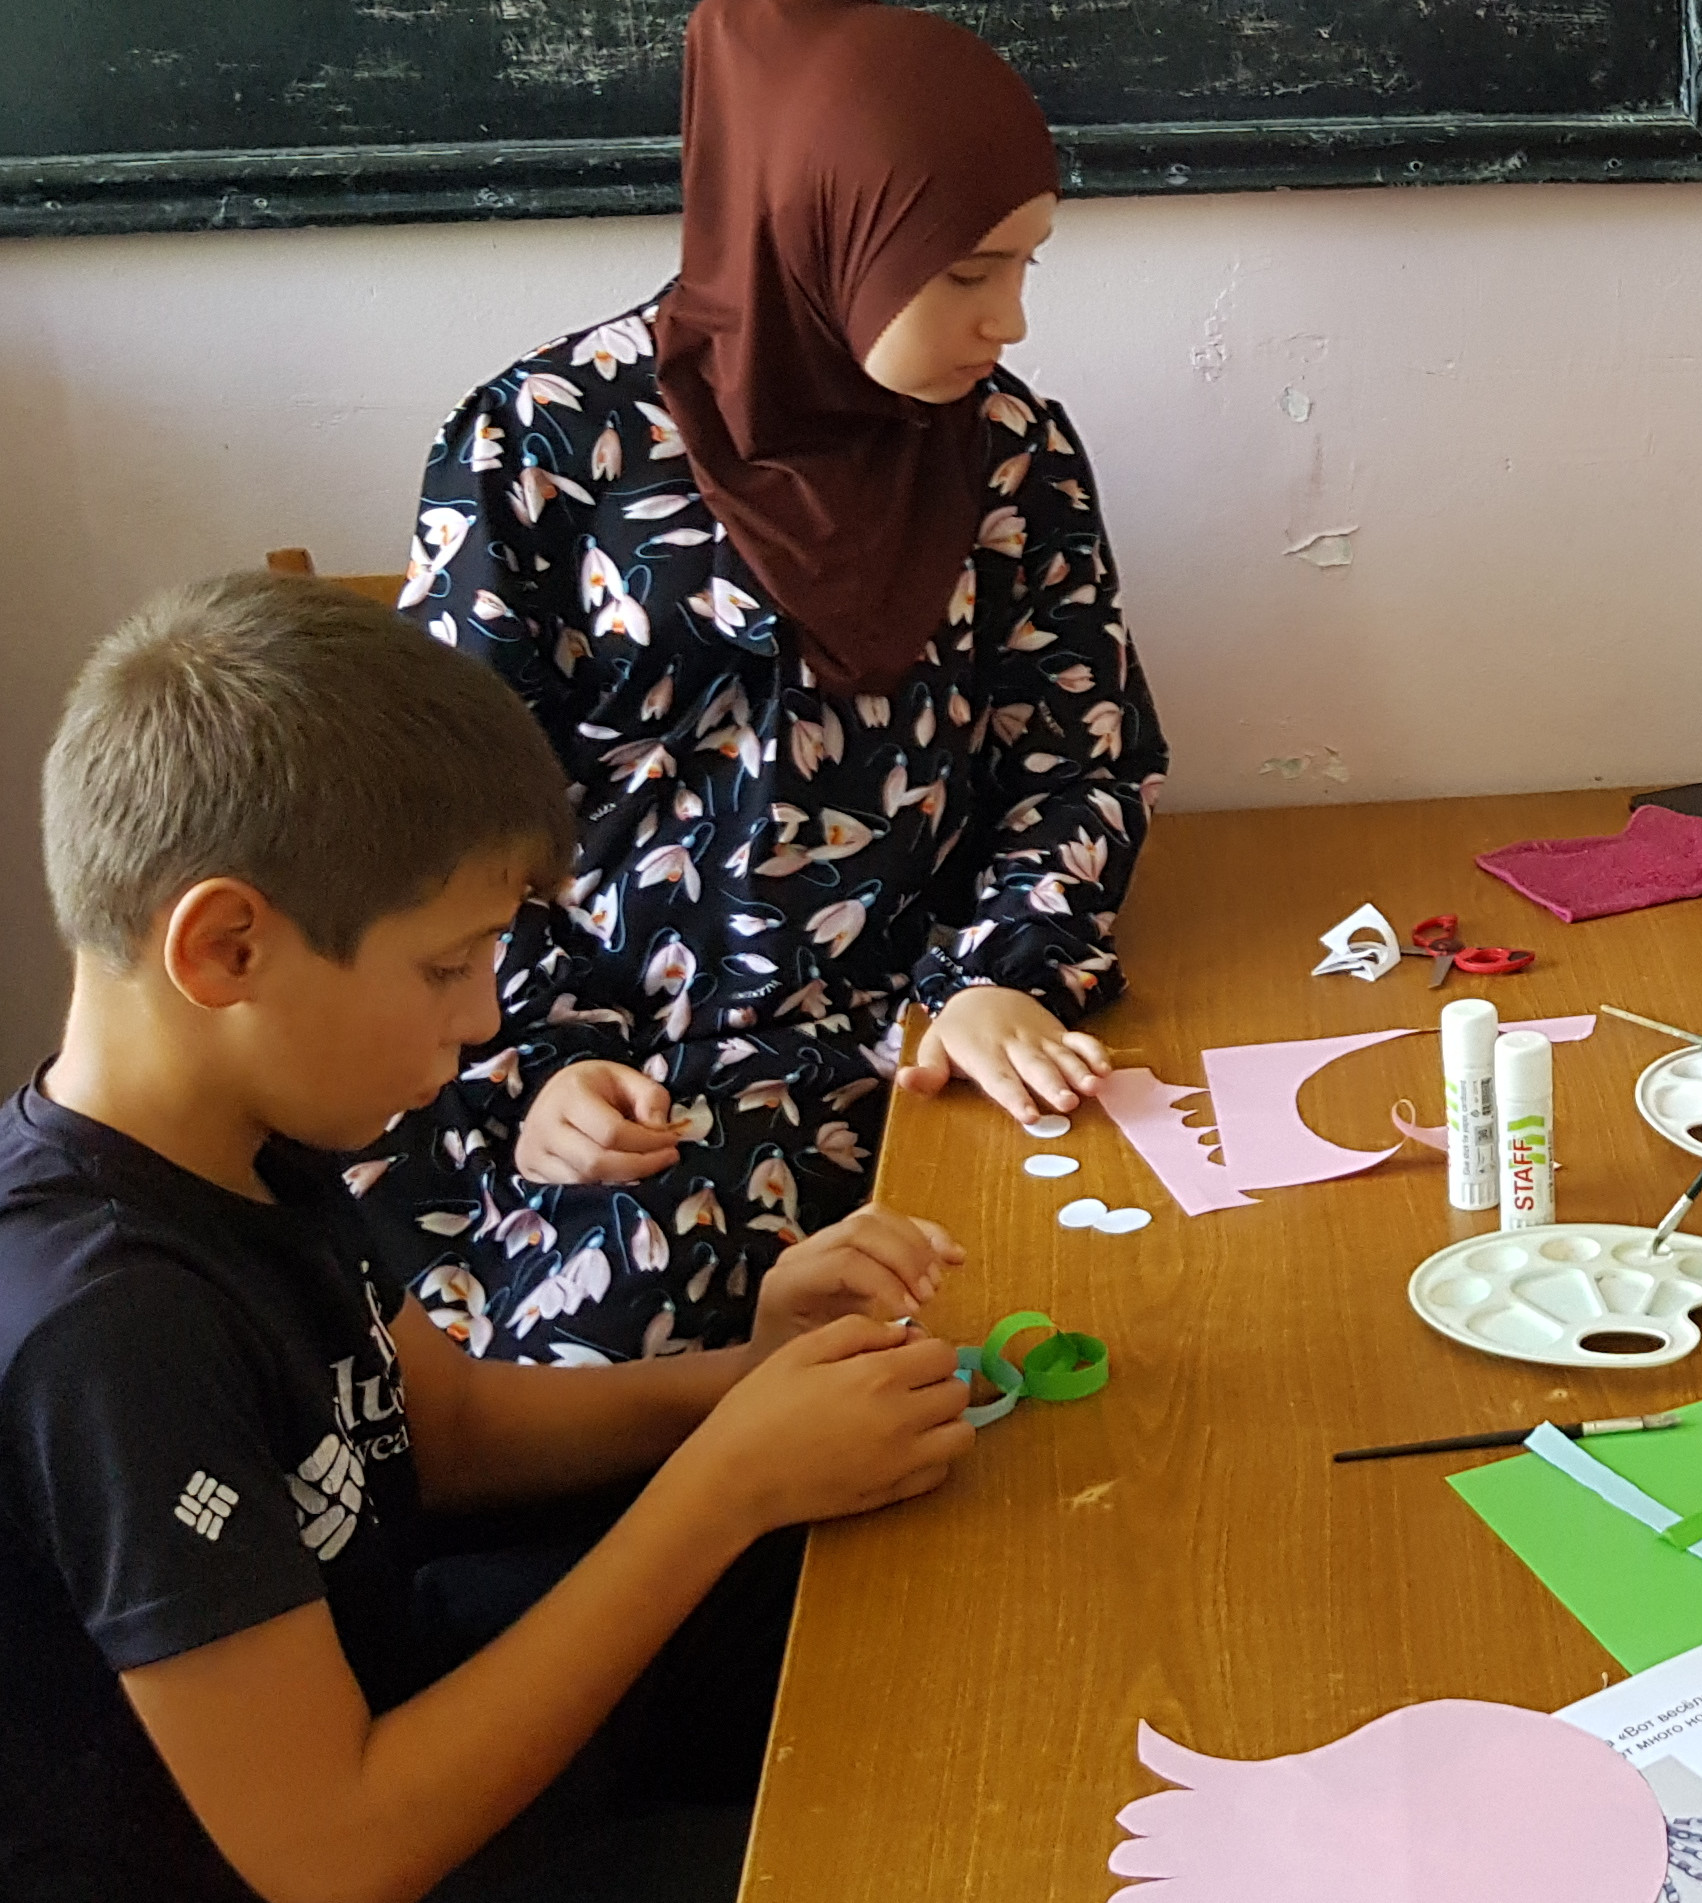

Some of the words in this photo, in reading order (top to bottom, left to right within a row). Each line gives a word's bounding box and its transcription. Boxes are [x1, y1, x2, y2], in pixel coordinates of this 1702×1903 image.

[1513, 1138, 1535, 1211] STAFF
[1618, 1719, 1655, 1741] «Вот
[1636, 1723, 1684, 1751] много
